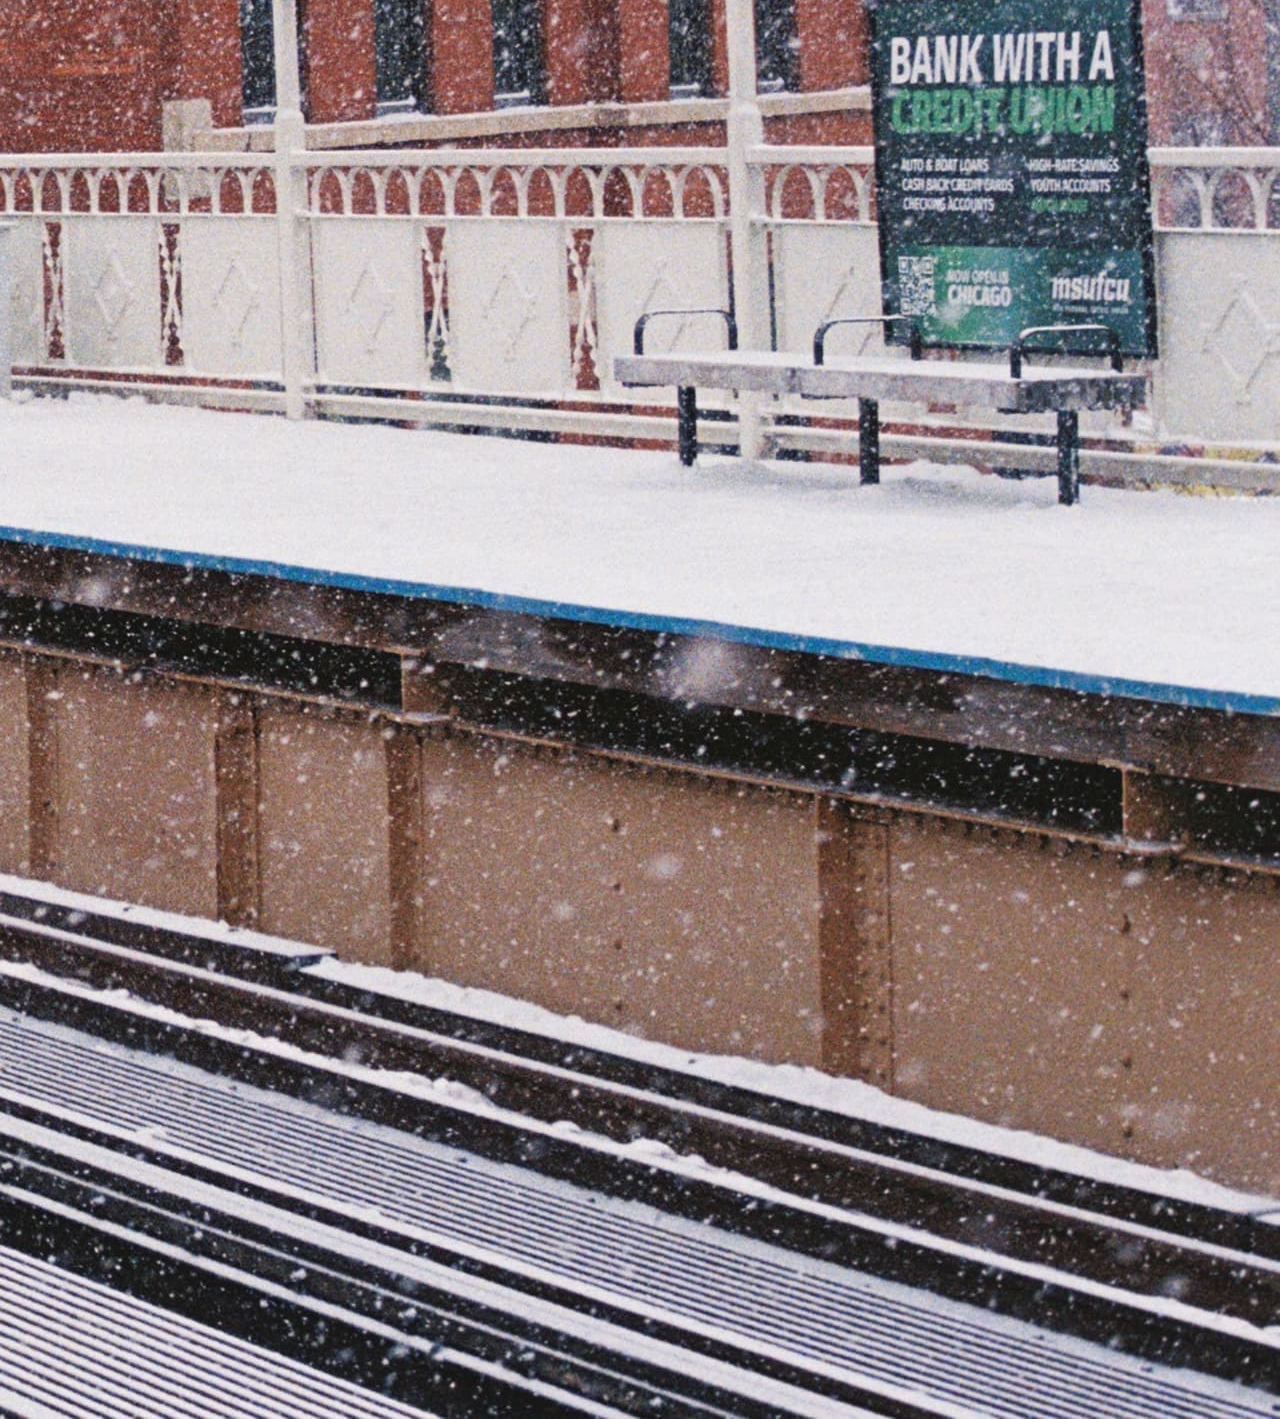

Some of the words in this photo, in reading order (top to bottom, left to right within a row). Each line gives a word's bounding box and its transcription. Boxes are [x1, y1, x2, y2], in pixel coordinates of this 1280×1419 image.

[890, 35, 984, 84] BANK
[993, 31, 1081, 82] WITH
[1088, 30, 1115, 81] A
[891, 87, 1006, 134] CREDIT
[1009, 84, 1116, 134] UNION
[901, 159, 925, 172] AUTO
[902, 178, 925, 191] CASH
[948, 285, 1012, 307] CHICAGO
[1051, 271, 1131, 301] msufcu
